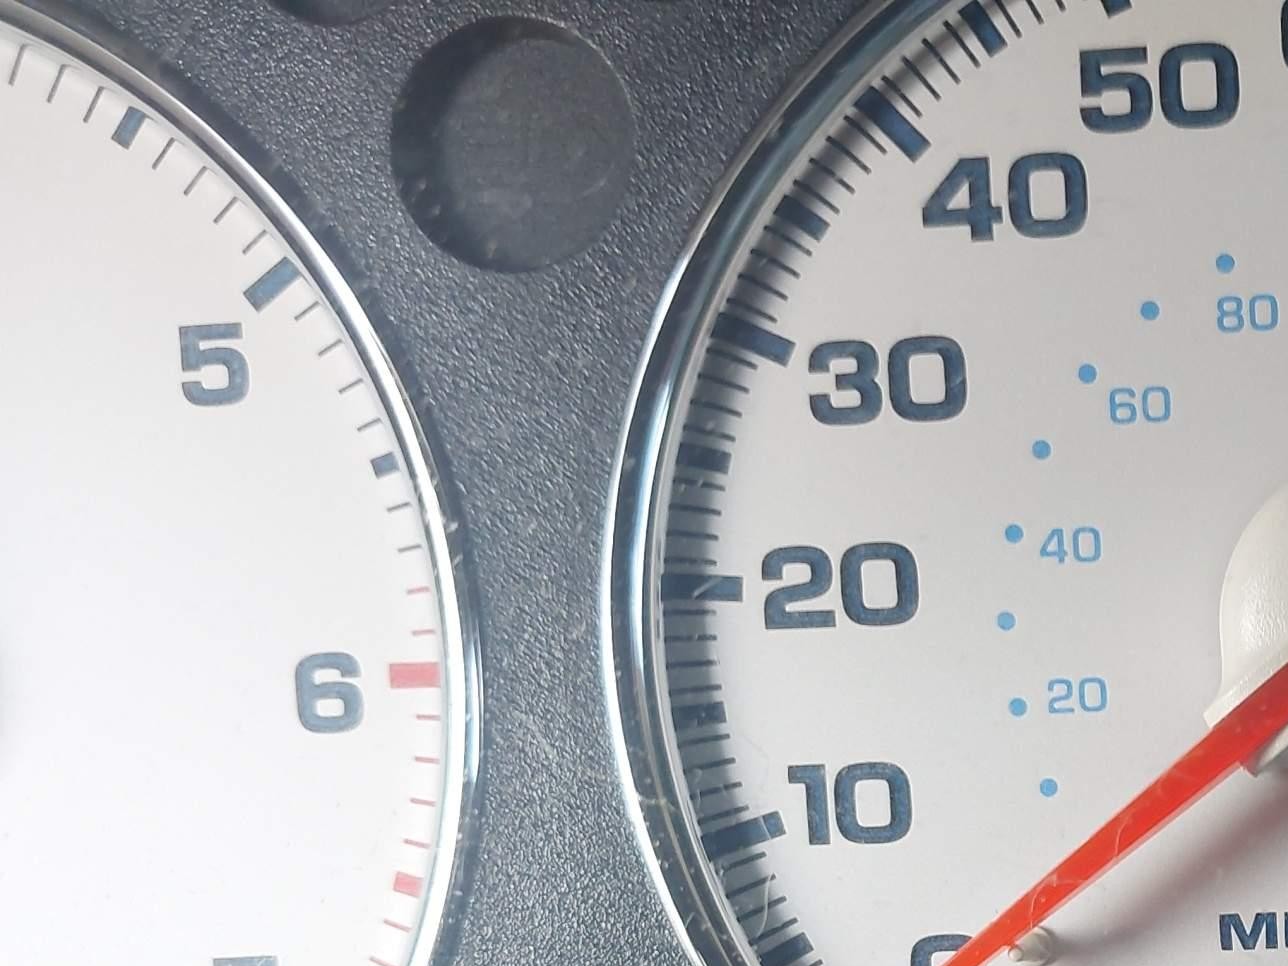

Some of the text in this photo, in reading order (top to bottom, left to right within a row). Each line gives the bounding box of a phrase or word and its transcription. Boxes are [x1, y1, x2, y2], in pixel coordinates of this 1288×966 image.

[1080, 42, 1240, 133] 50
[922, 152, 1088, 241] 40
[1217, 295, 1279, 332] 80
[179, 323, 251, 407] 5
[808, 335, 967, 426] 30
[1109, 386, 1172, 424] 60
[762, 542, 920, 631] 20
[1040, 527, 1102, 564] 40
[295, 652, 364, 734] 6
[1047, 677, 1108, 714] 20
[788, 762, 912, 846] 10
